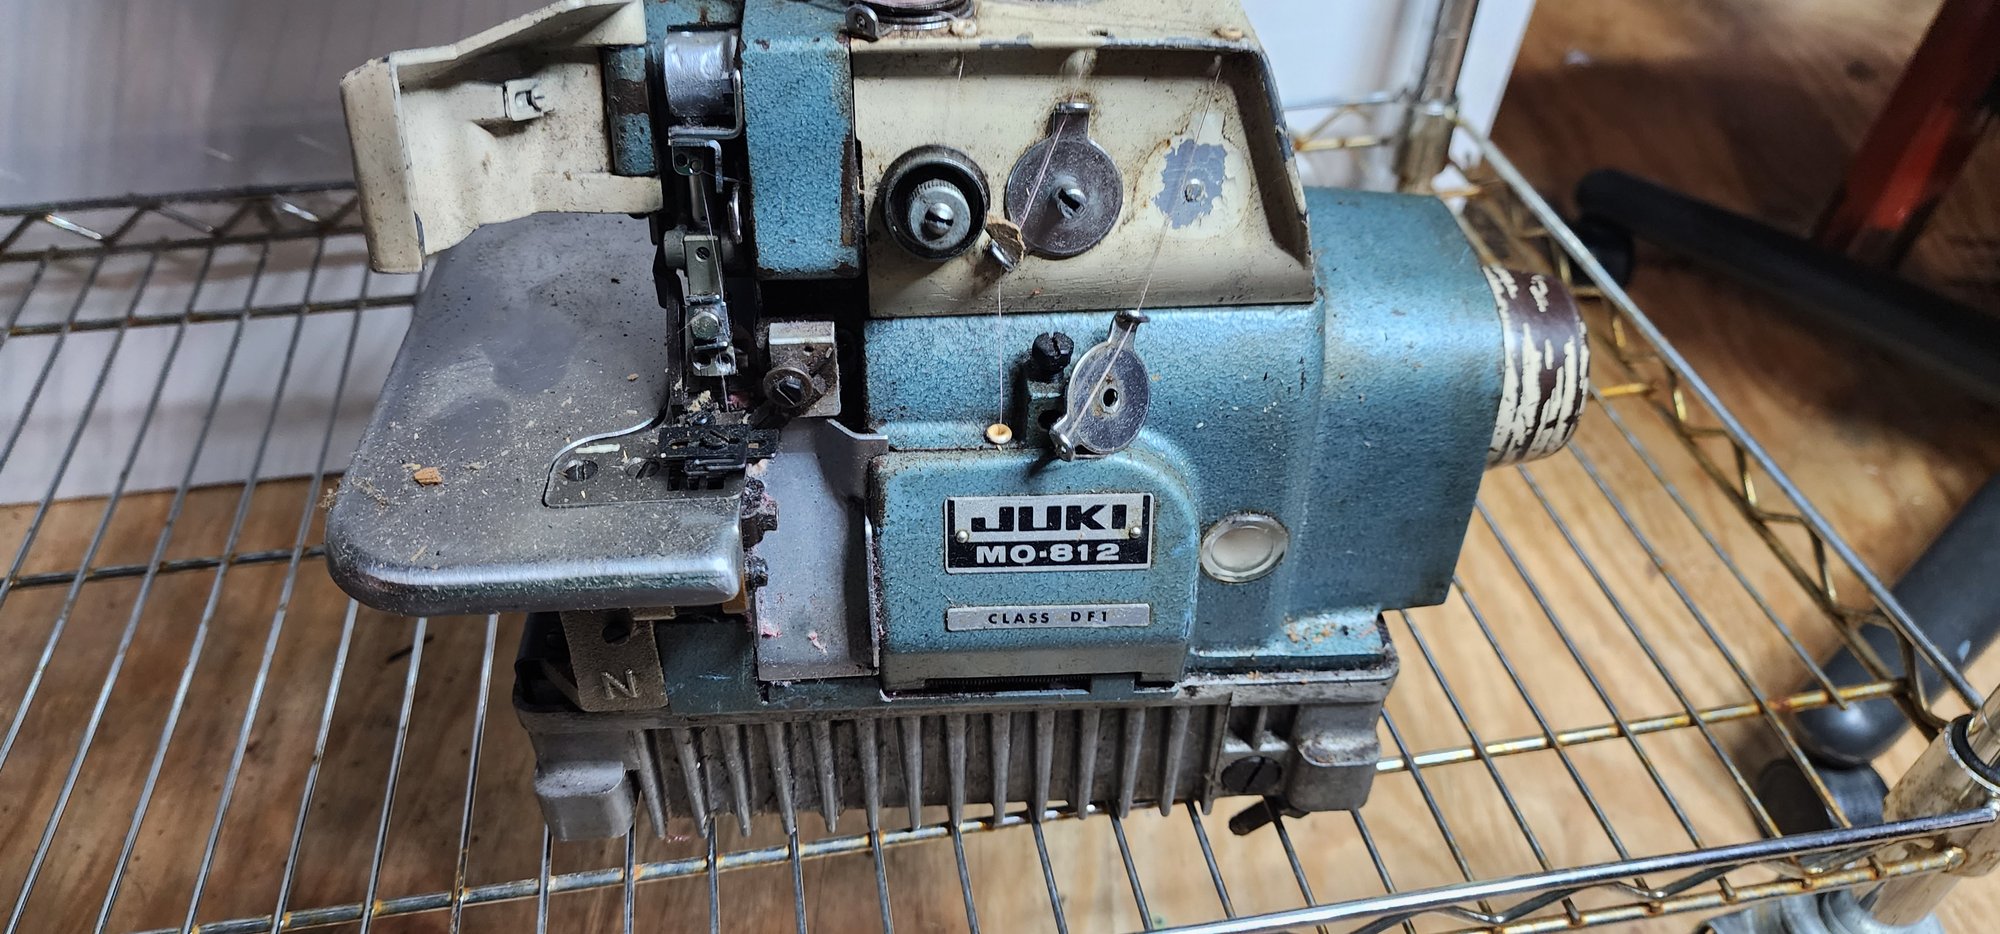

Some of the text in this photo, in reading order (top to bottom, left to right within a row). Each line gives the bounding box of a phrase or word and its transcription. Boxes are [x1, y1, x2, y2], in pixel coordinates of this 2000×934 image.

[971, 504, 1127, 532] JUKI
[988, 612, 1050, 625] CLASS
[601, 668, 639, 700] N
